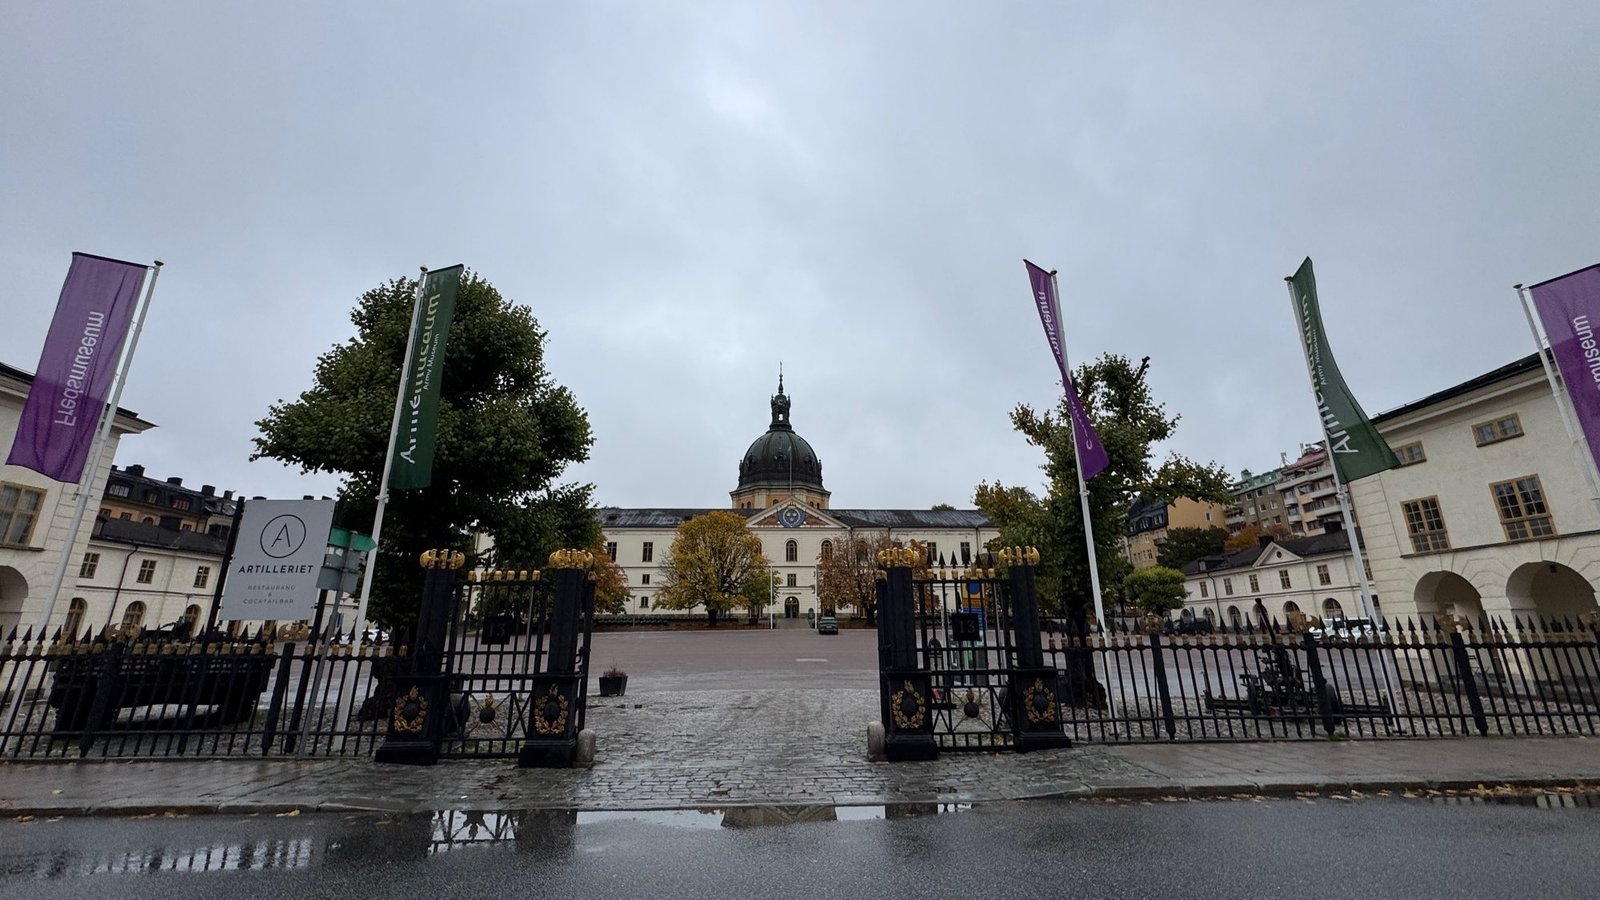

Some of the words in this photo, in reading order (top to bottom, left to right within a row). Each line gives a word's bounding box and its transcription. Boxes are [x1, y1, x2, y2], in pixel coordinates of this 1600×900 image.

[426, 333, 440, 367] Museum
[1573, 315, 1600, 391] museum
[422, 369, 432, 390] Army
[270, 522, 291, 548] A
[238, 564, 314, 574] ARTILLERIET
[489, 622, 506, 637] 13
[959, 619, 976, 634] 13
